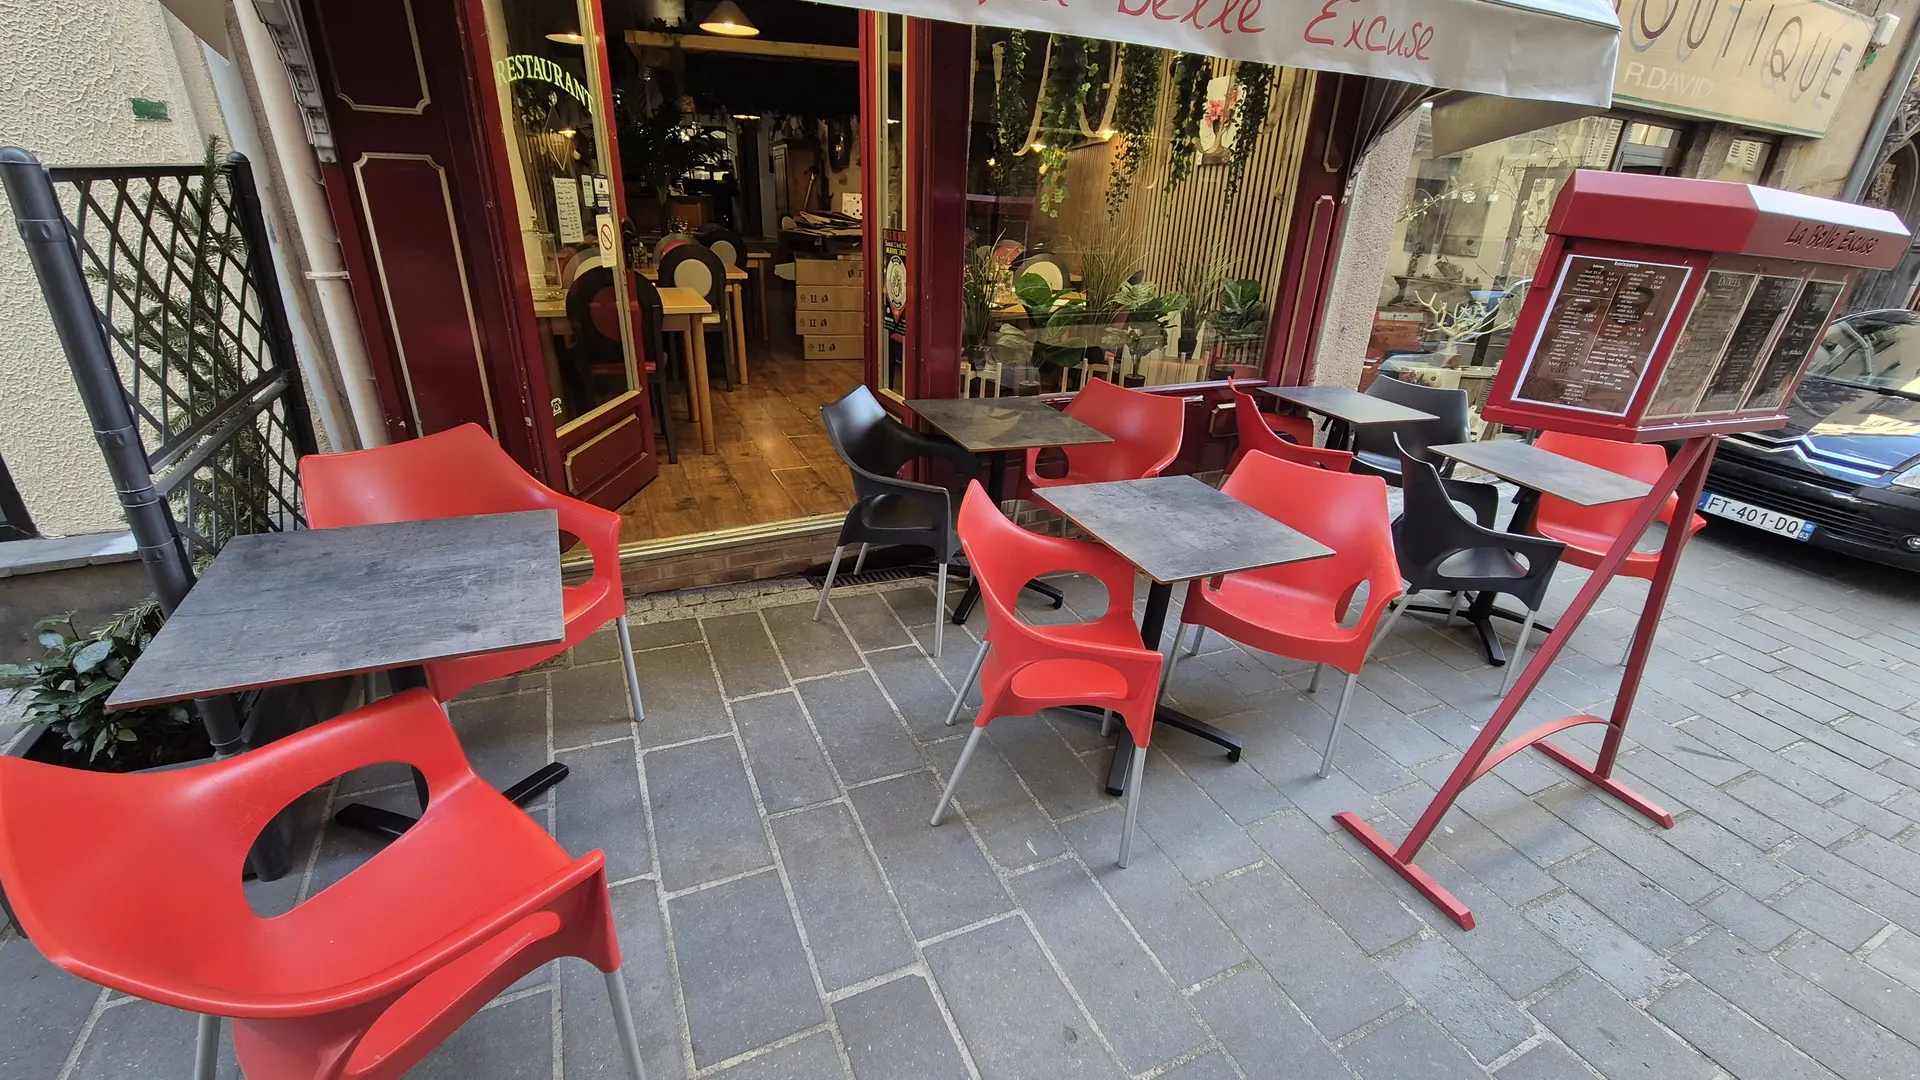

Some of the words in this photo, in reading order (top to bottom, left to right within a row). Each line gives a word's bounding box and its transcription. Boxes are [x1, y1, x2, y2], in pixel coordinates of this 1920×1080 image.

[1118, 0, 1265, 33] elle
[1304, 0, 1434, 61] Excuse
[1615, 0, 1852, 101] OUTIQUE
[495, 54, 594, 115] RESTAURANT
[1623, 61, 1715, 98] R.DAVID
[1785, 221, 1808, 245] La
[1805, 224, 1840, 250] Belle
[1836, 229, 1878, 255] Excuse
[1708, 497, 1799, 534] FT-401-DQ
